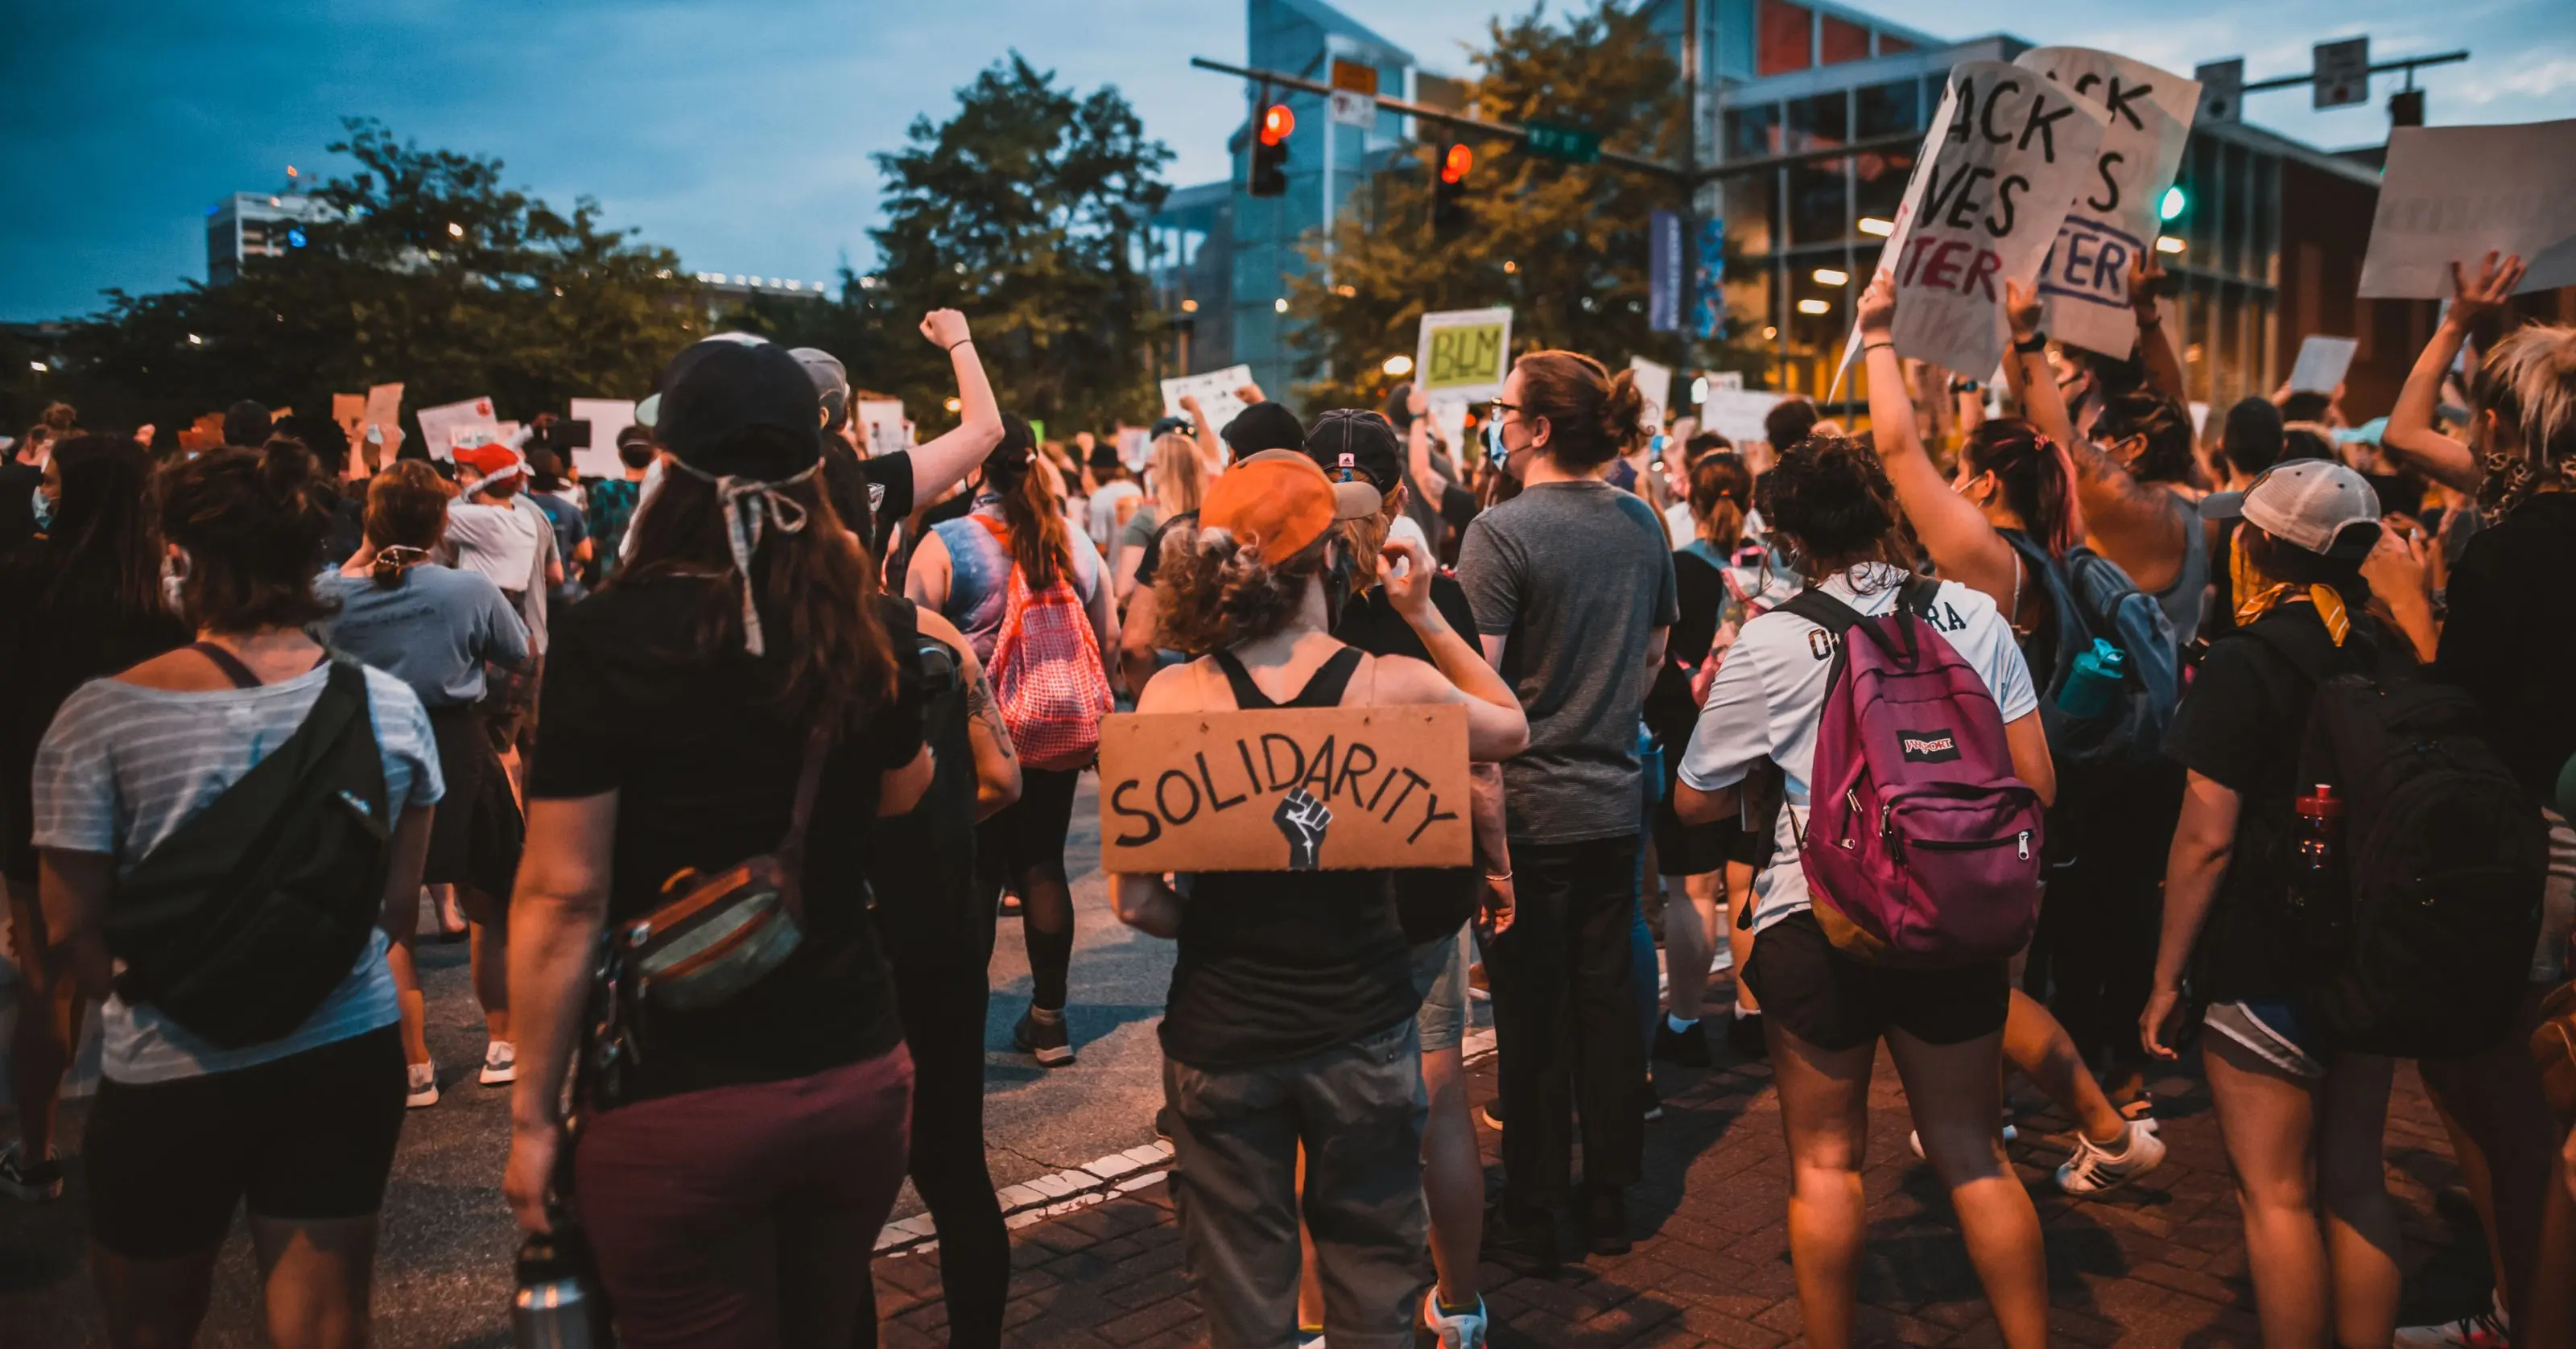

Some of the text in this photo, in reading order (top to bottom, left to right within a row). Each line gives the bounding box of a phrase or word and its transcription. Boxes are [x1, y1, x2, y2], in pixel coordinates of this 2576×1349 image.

[1903, 237, 2002, 303] TER
[1430, 328, 1501, 382] BLM
[1111, 733, 1459, 847] SOLIDARITY
